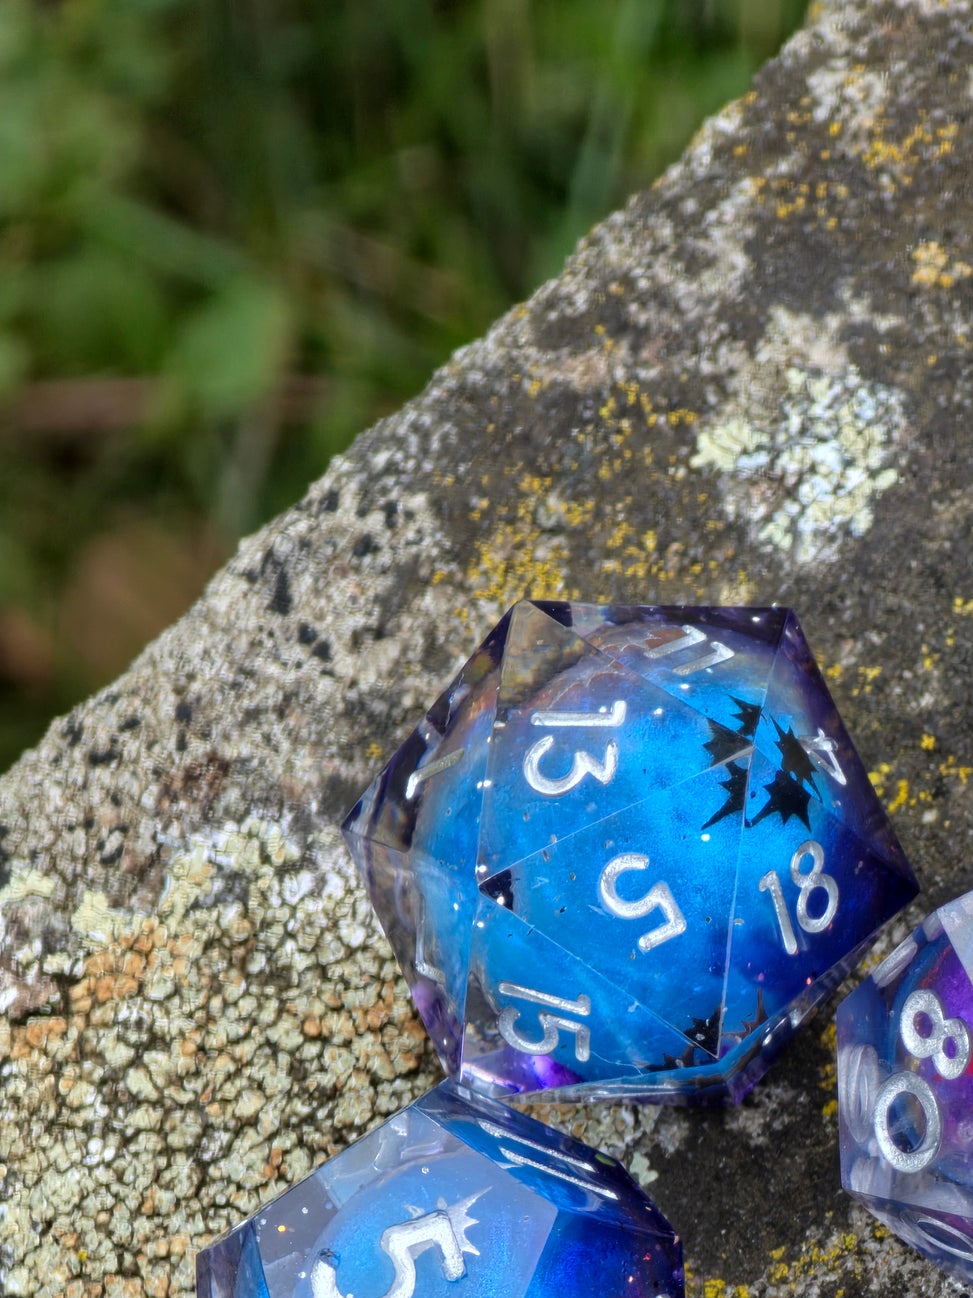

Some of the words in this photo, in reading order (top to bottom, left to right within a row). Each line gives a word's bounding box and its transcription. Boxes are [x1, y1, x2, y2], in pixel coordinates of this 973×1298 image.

[523, 700, 627, 797] 13
[599, 852, 687, 952] 5
[757, 839, 840, 955] 18
[498, 981, 591, 1063] 15
[872, 988, 972, 1174] 80
